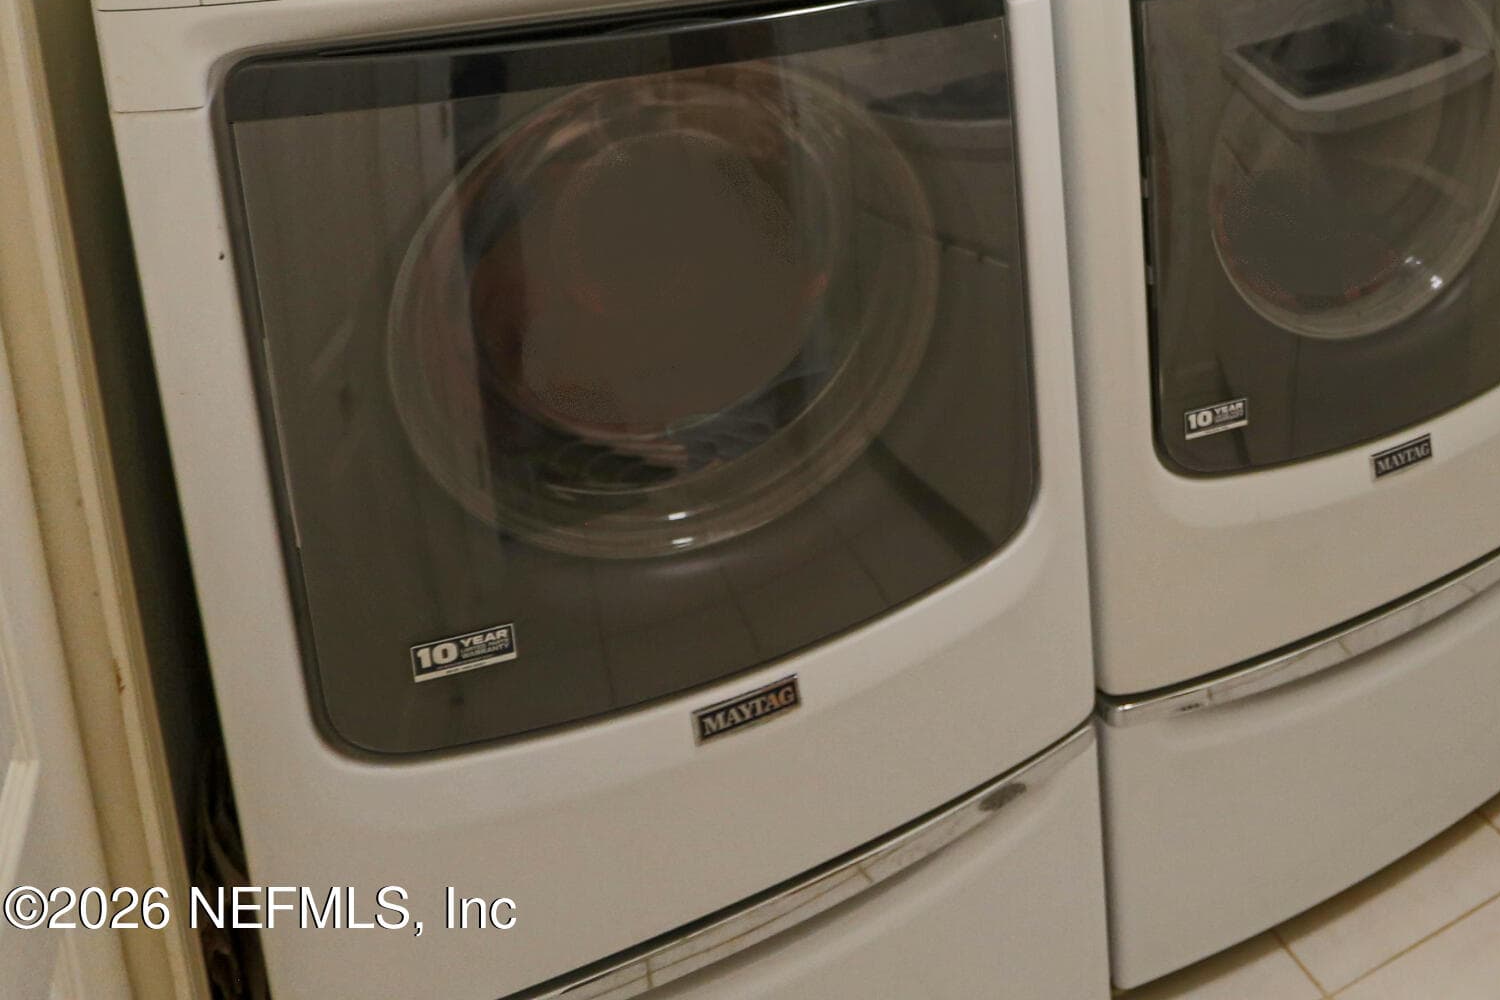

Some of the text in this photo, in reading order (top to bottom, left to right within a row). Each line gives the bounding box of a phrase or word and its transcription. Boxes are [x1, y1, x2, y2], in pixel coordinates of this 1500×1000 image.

[1187, 410, 1213, 430] 10
[1214, 402, 1244, 415] YEAR
[1377, 442, 1431, 474] MAYTAG
[416, 642, 458, 669] 10
[460, 629, 508, 648] YEAR
[702, 685, 795, 736] MAYTAG
